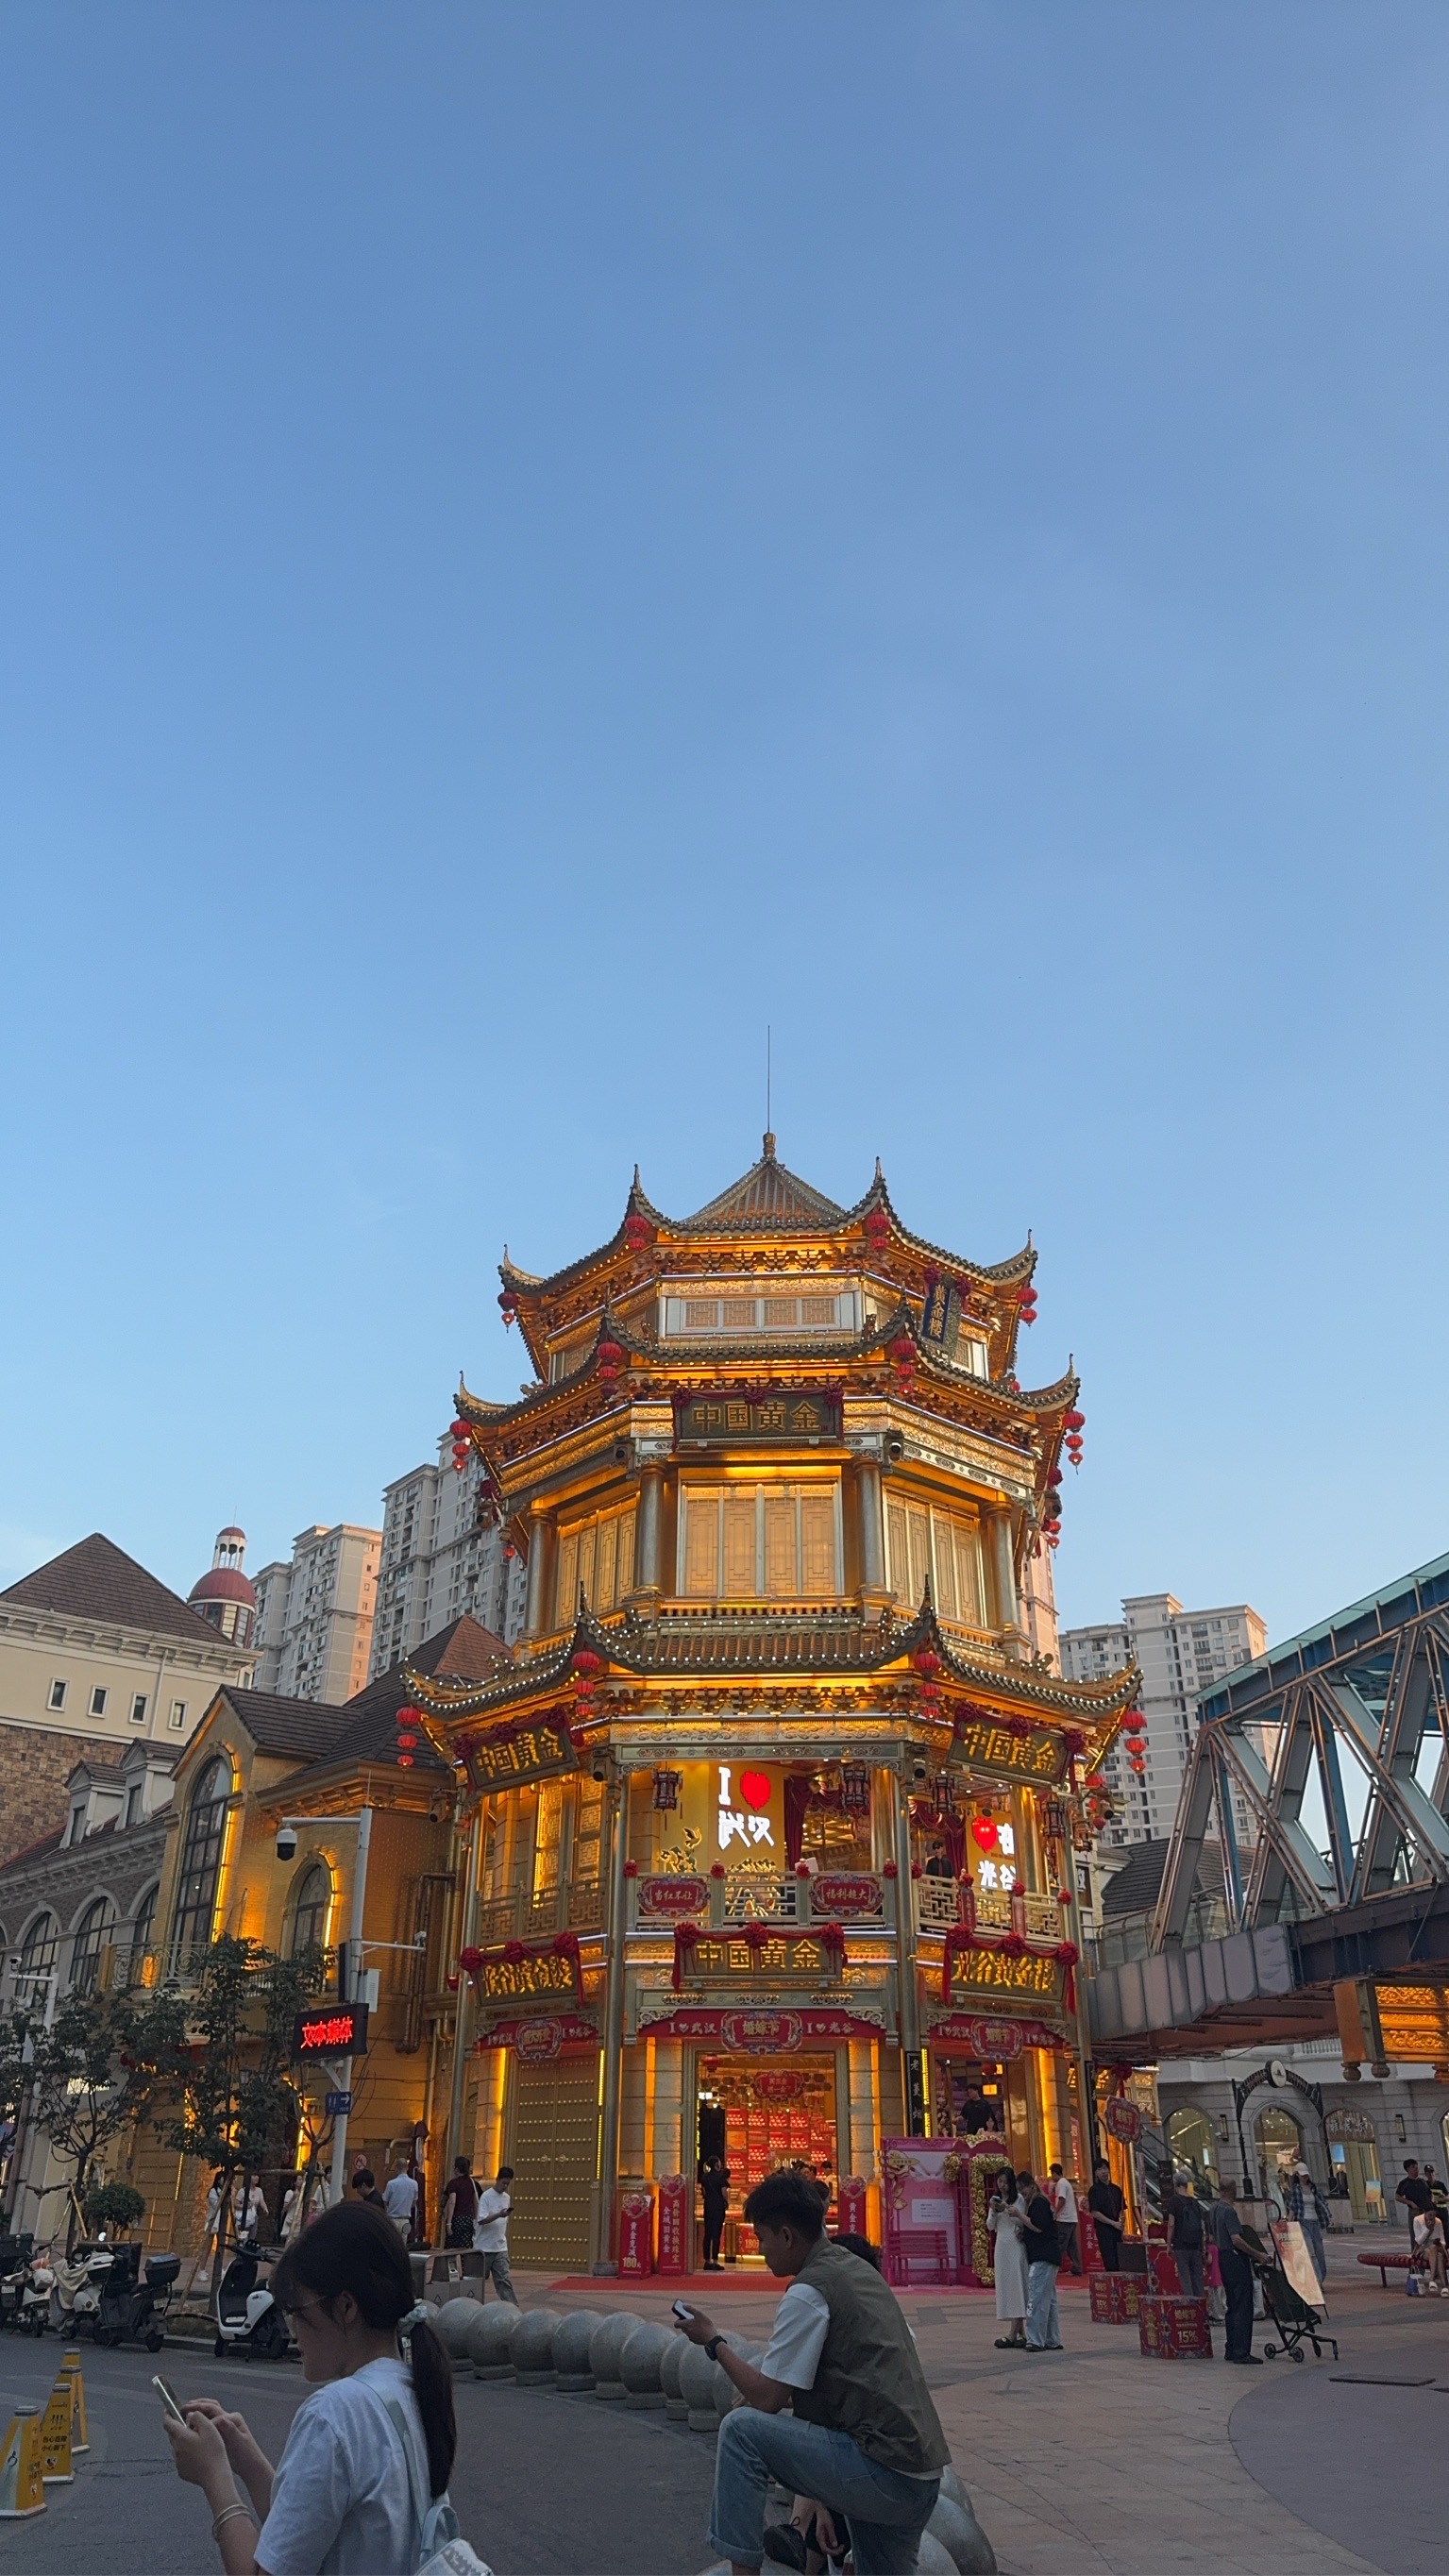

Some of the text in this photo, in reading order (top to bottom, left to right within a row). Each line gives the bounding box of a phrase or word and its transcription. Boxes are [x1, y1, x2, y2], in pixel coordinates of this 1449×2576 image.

[928, 1284, 946, 1339] 黄金楼
[693, 1400, 821, 1432] 中国黄金
[476, 1727, 563, 1778] 中国黄金
[964, 1724, 1057, 1773] 中国黄金
[718, 1766, 731, 1805] I
[718, 1810, 775, 1850] 武汉
[696, 1939, 821, 1971] 中国黄金
[691, 2022, 717, 2035] 武汉
[742, 2020, 781, 2036] 婚嫁节
[829, 2021, 854, 2034] 光谷
[1178, 2331, 1199, 2343] 15%
